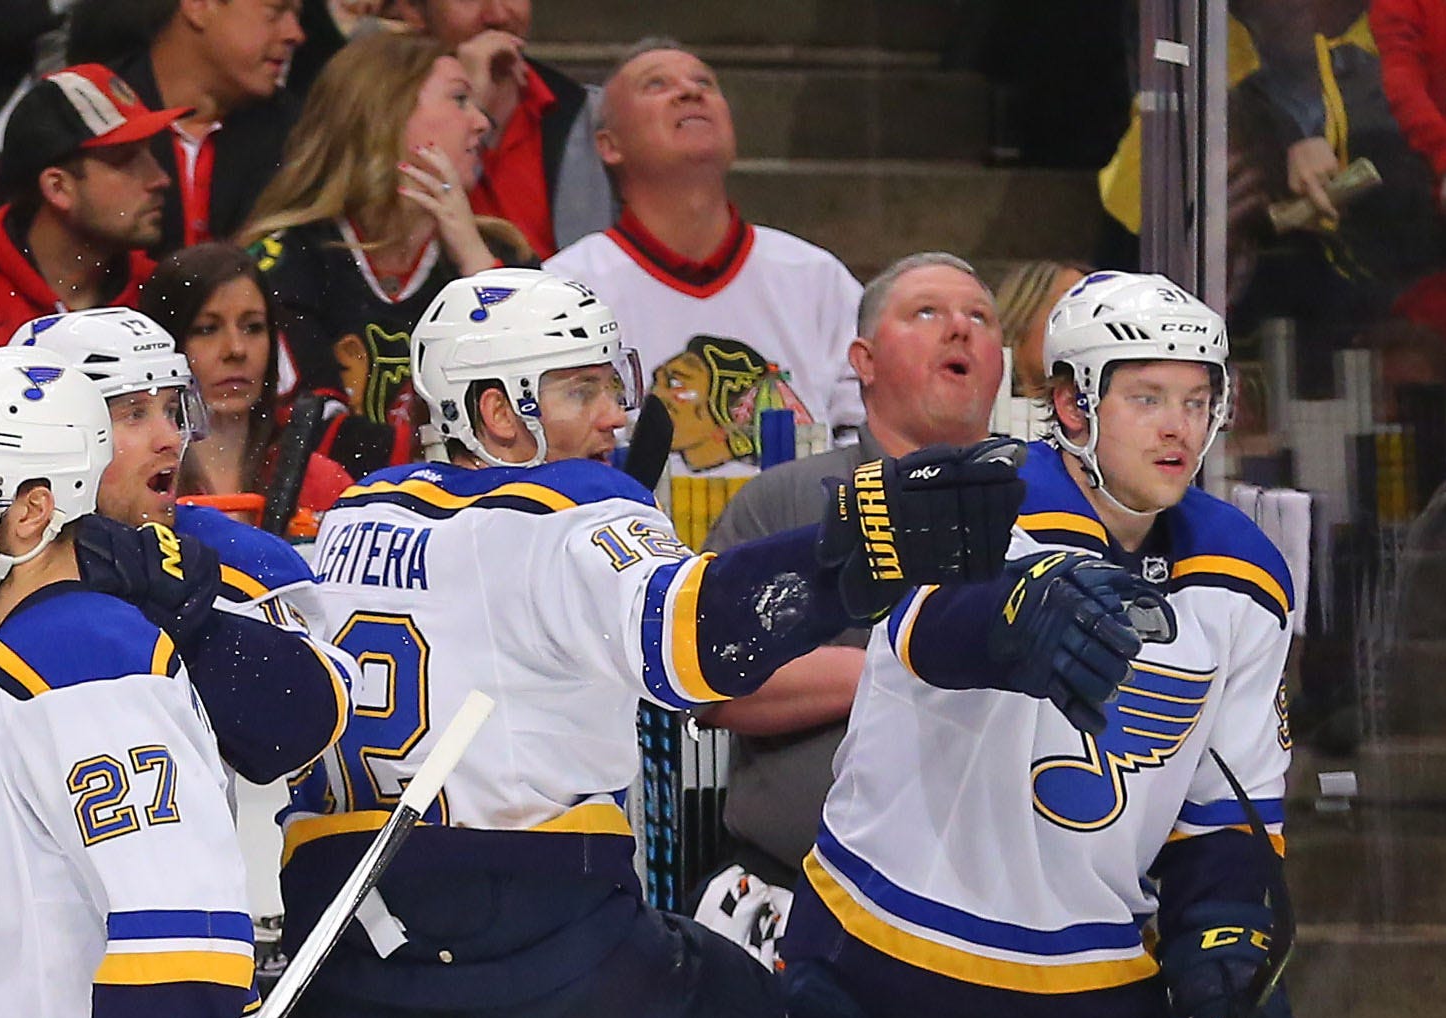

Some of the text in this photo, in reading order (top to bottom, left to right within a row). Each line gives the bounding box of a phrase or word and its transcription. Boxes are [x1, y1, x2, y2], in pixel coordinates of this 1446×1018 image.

[1161, 323, 1208, 334] CCM
[133, 343, 171, 352] EASTON
[591, 519, 692, 573] 12
[65, 744, 181, 848] 27
